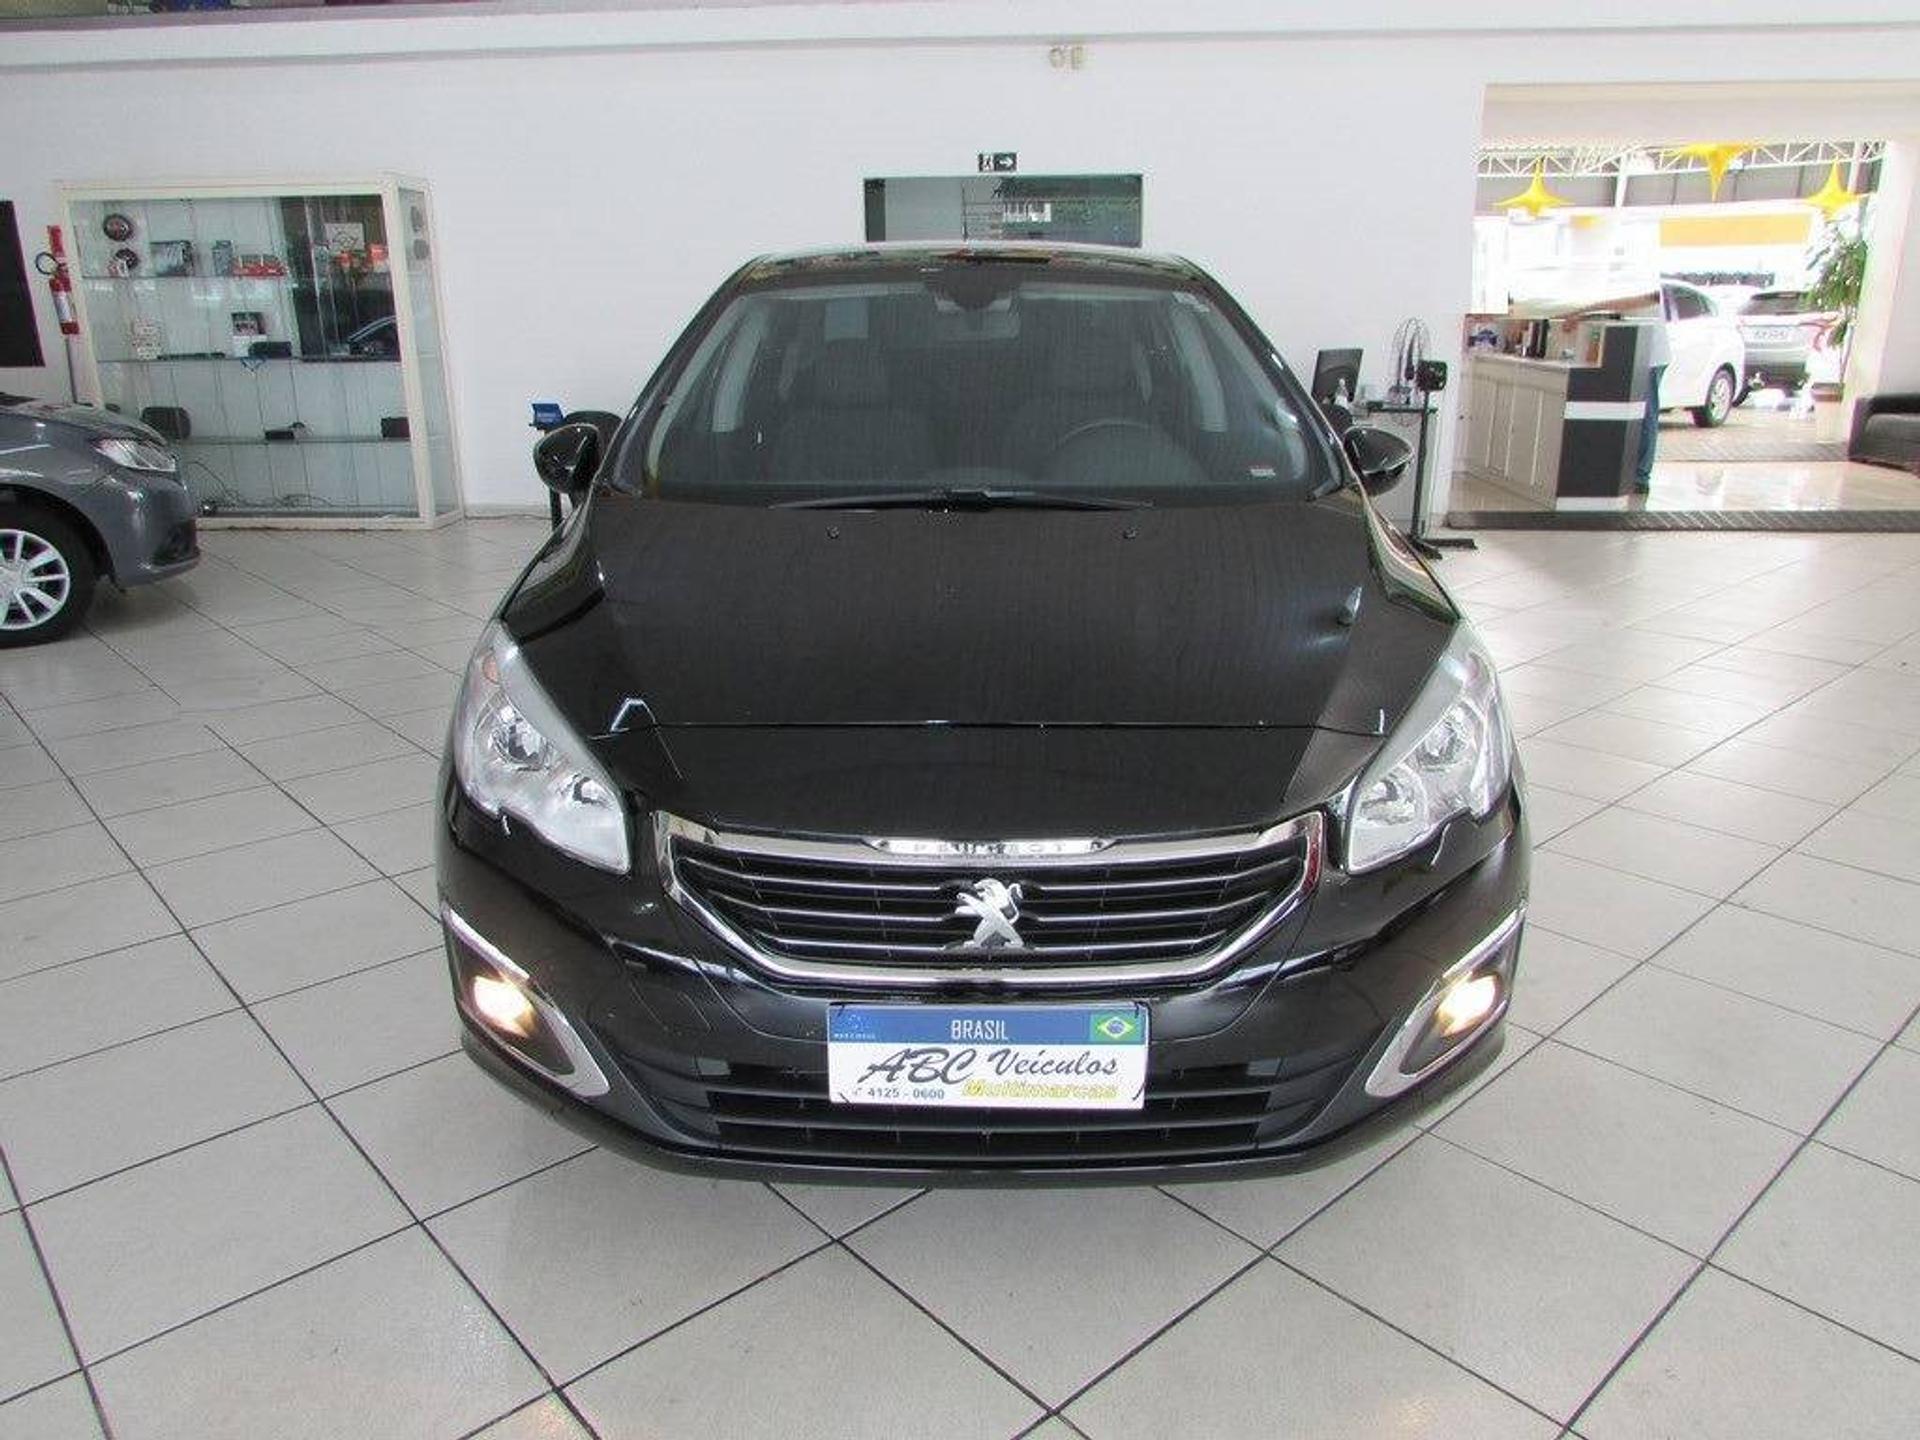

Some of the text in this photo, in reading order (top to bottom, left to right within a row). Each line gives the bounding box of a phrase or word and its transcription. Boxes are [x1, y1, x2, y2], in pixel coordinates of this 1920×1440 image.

[951, 1019, 1009, 1041] BRASIL
[857, 1047, 1119, 1085] ABC Veículos
[867, 1087, 900, 1099] 4125
[912, 1088, 945, 1100] 0600
